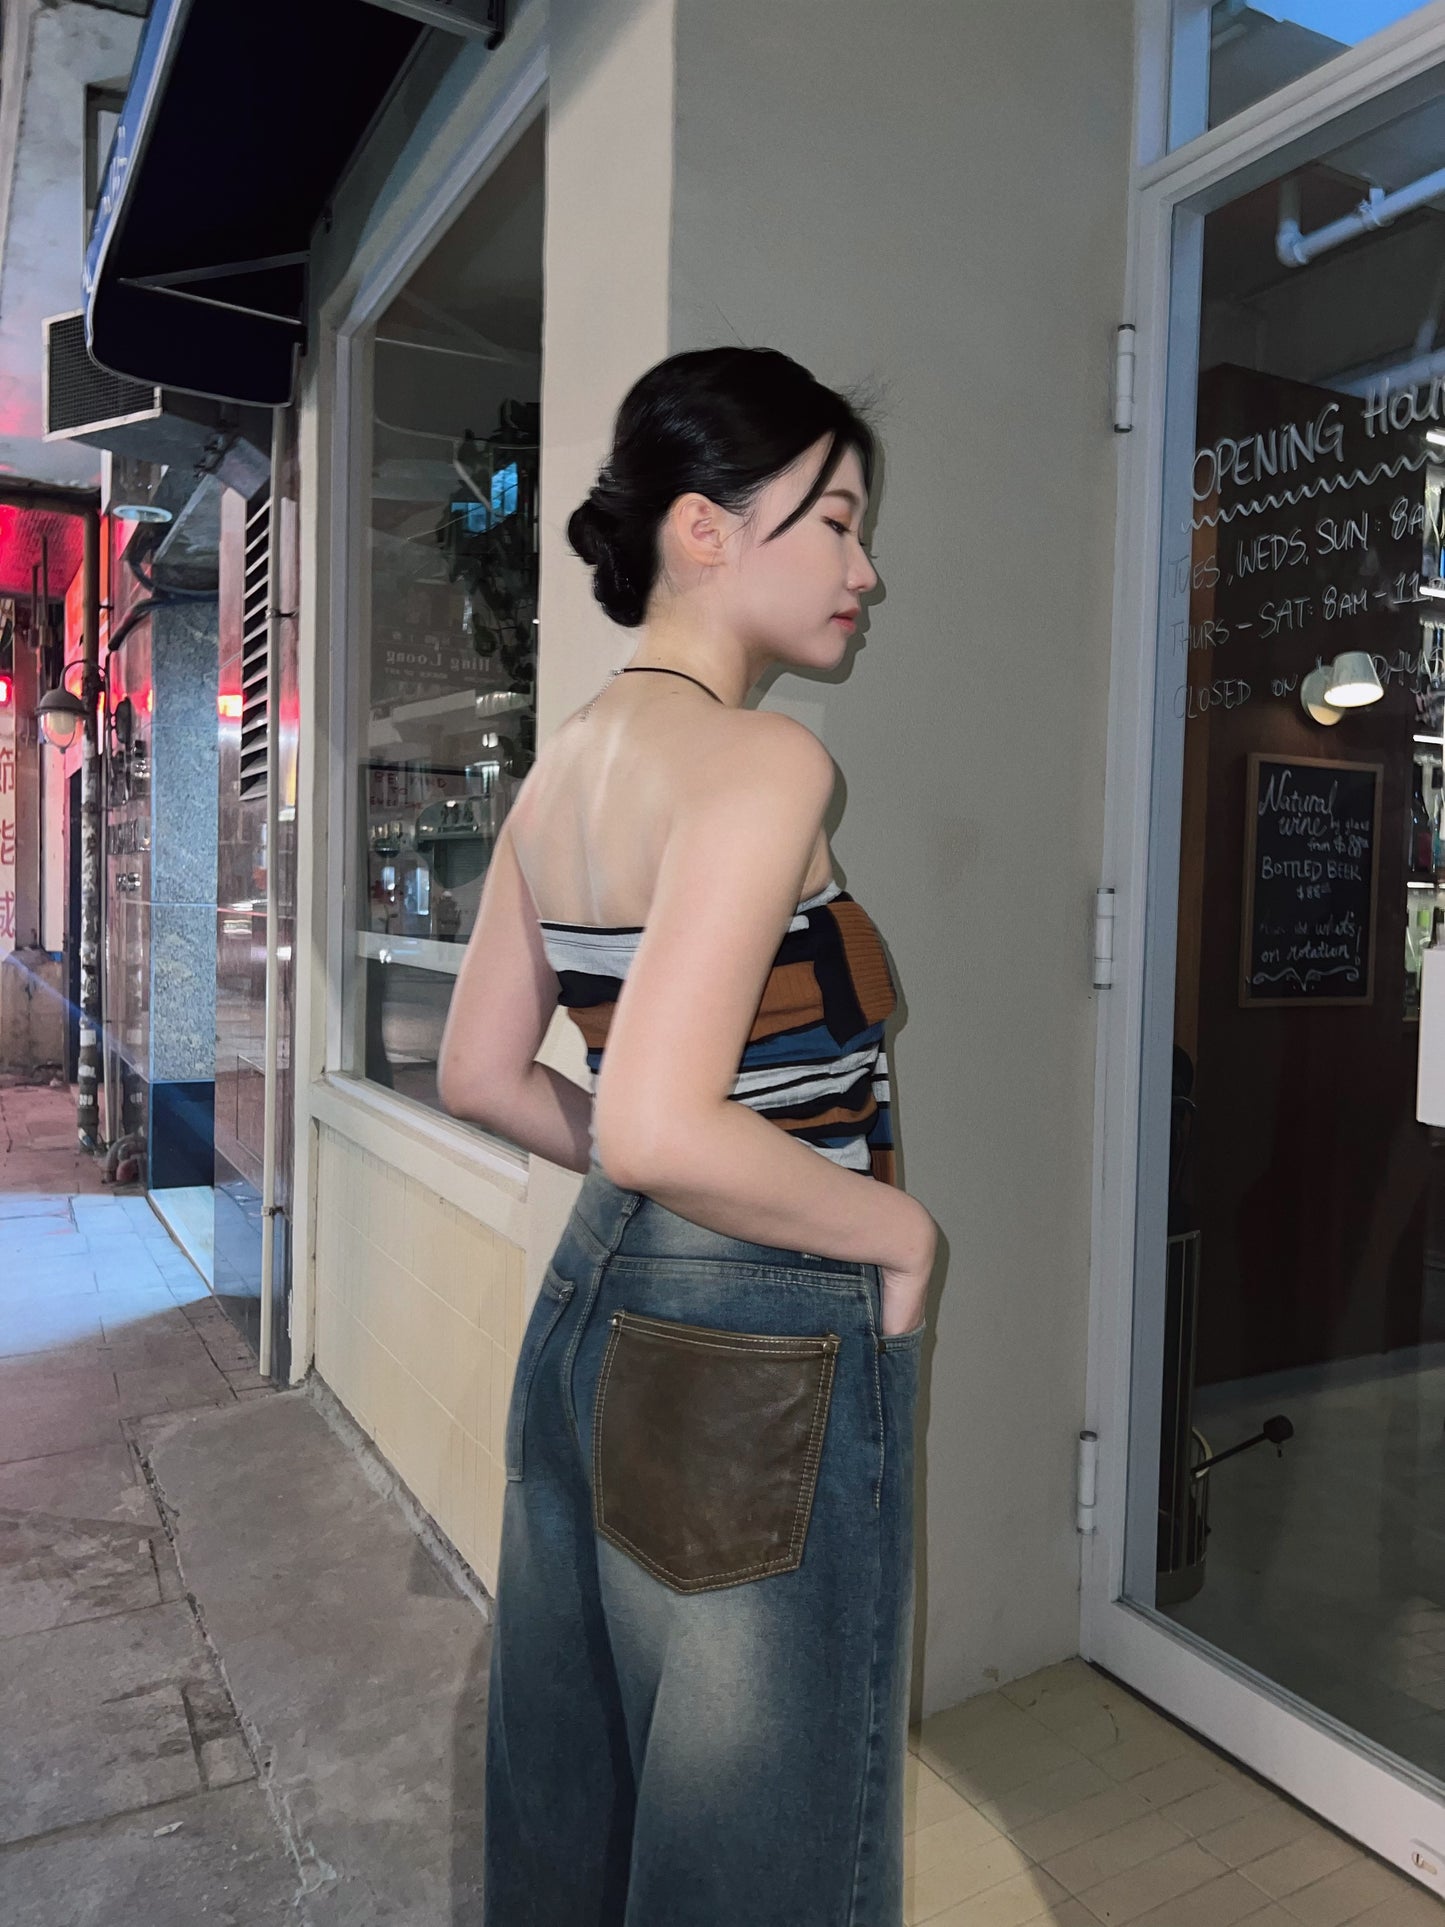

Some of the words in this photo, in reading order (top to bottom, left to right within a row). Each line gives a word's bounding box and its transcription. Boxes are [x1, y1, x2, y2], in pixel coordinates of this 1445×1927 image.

[1360, 374, 1445, 439] HOU
[1236, 528, 1309, 578] WEDS,
[1323, 584, 1368, 622] 8AM
[1173, 678, 1251, 719] CLOSED
